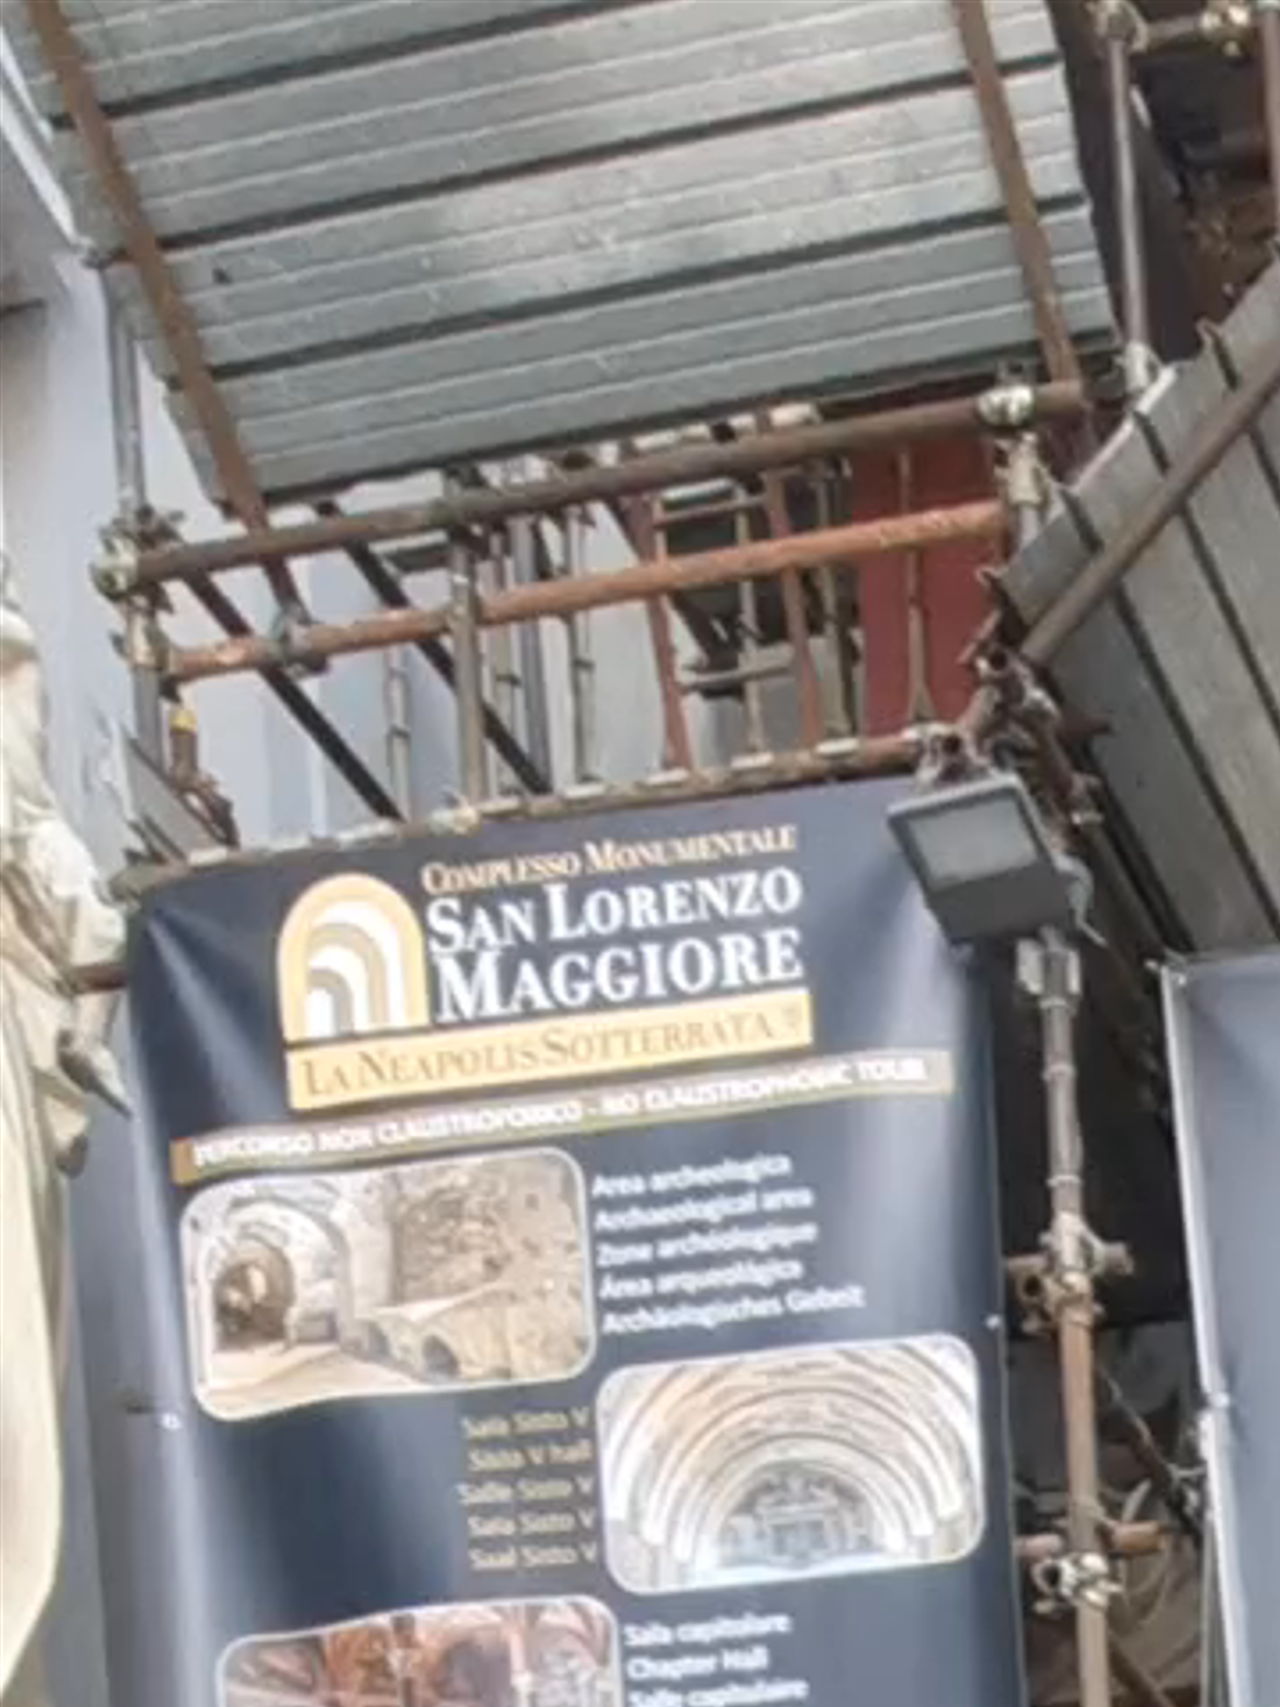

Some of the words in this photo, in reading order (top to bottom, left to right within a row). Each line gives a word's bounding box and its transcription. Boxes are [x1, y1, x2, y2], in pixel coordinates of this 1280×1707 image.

[421, 851, 581, 895] COMPLESSO
[584, 825, 796, 873] MONUMENTALE
[427, 898, 535, 953] SAN
[544, 866, 802, 940] LORENZO
[431, 928, 803, 1023] MAGGIORE
[303, 1060, 350, 1096] LA
[357, 1044, 538, 1086] NEAPOLIS
[534, 1013, 773, 1067] SOTTERRATA
